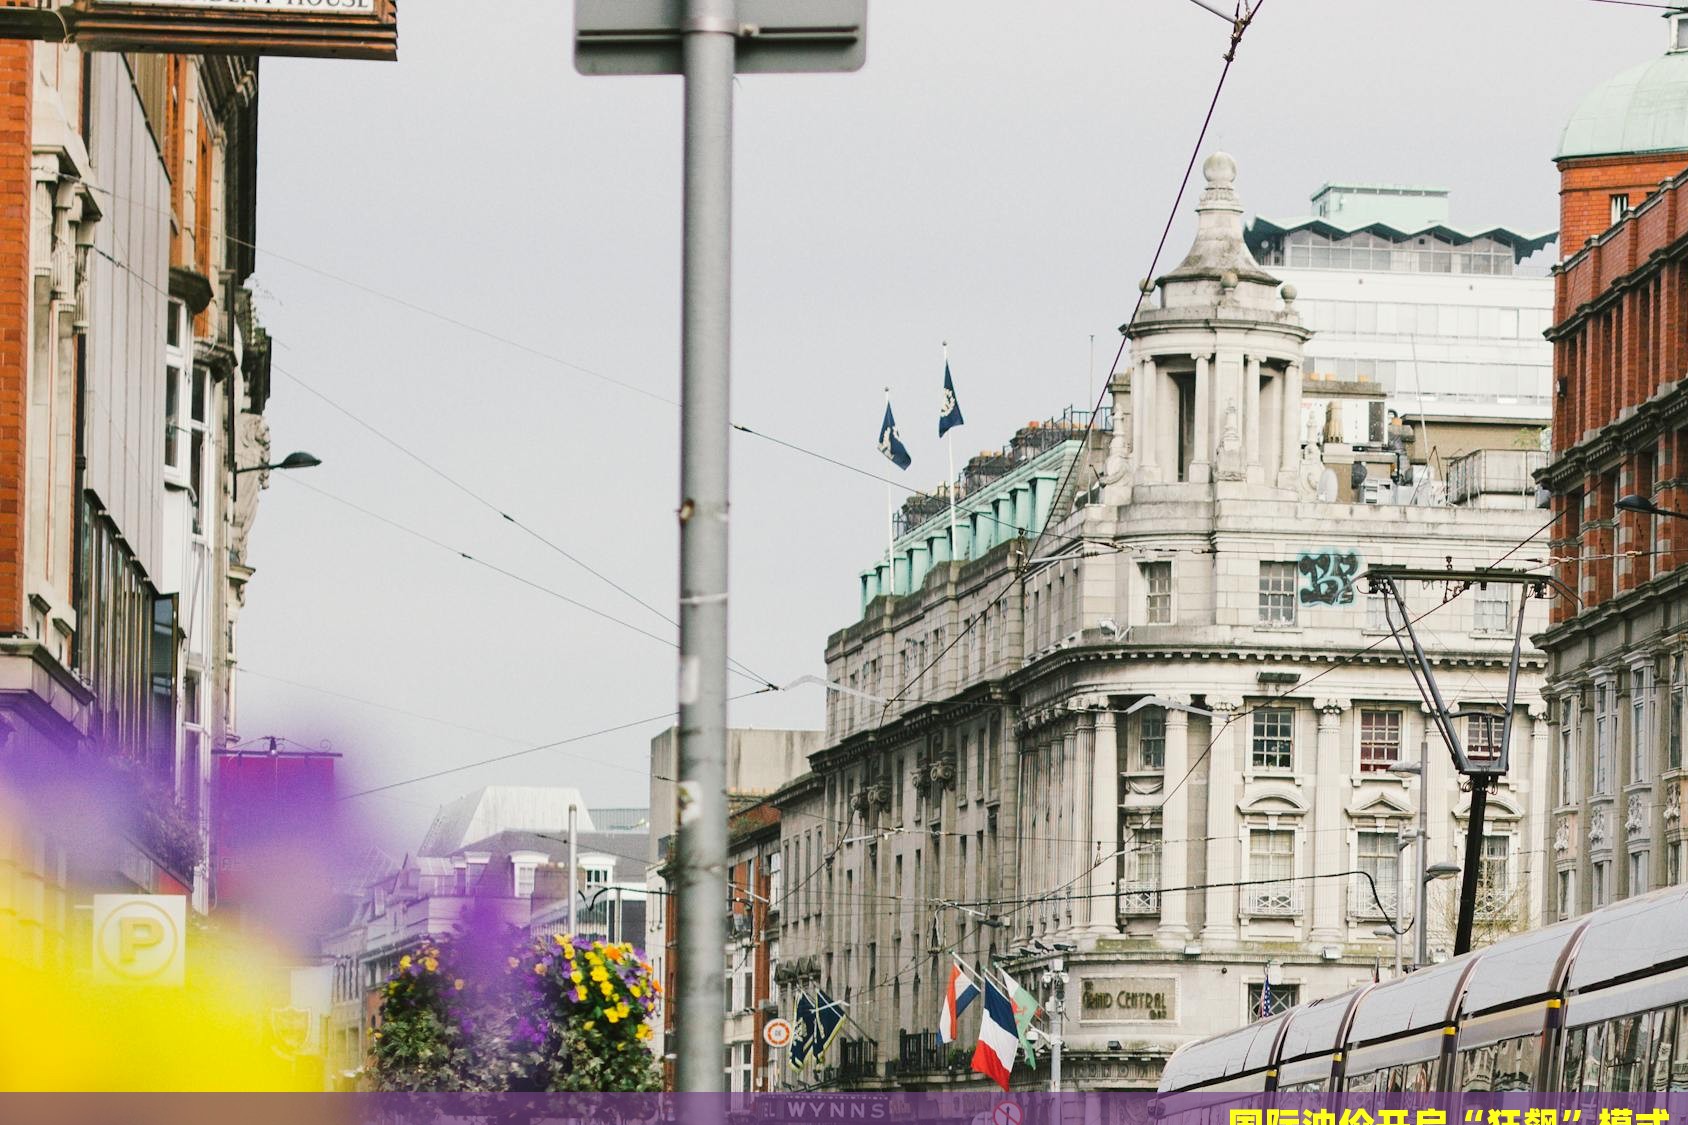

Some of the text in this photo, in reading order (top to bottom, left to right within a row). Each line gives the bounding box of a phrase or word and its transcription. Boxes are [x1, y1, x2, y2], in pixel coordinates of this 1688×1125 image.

[118, 916, 165, 965] P
[1117, 990, 1167, 1010] CENTRAL
[787, 1101, 886, 1119] WYNNS
